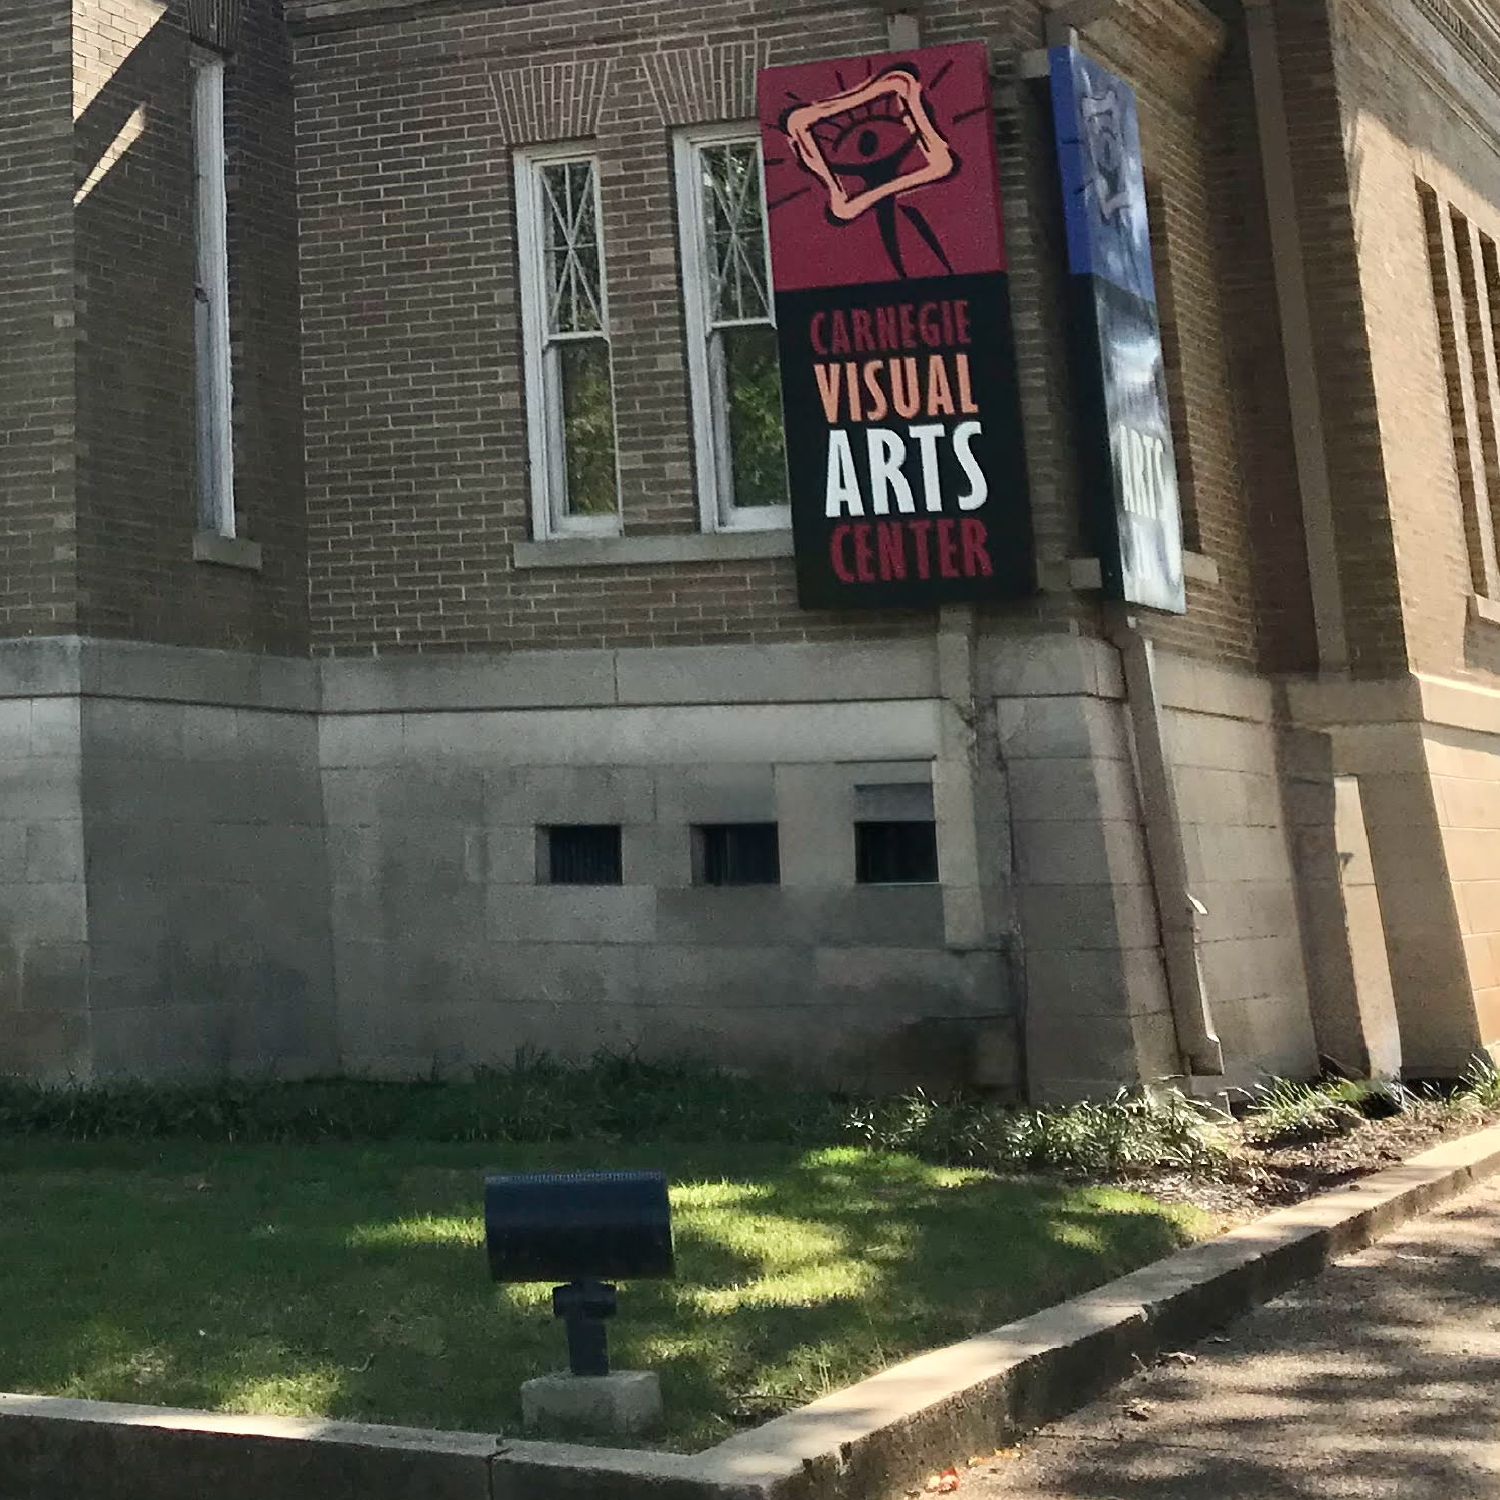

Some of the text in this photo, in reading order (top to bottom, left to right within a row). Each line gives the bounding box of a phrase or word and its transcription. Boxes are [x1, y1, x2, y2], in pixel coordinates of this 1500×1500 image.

[810, 300, 972, 357] CARNEGIE
[813, 353, 979, 425] VISUAL
[825, 421, 989, 519] ARTS
[1119, 422, 1166, 521] ARTS
[829, 517, 994, 583] CENTER
